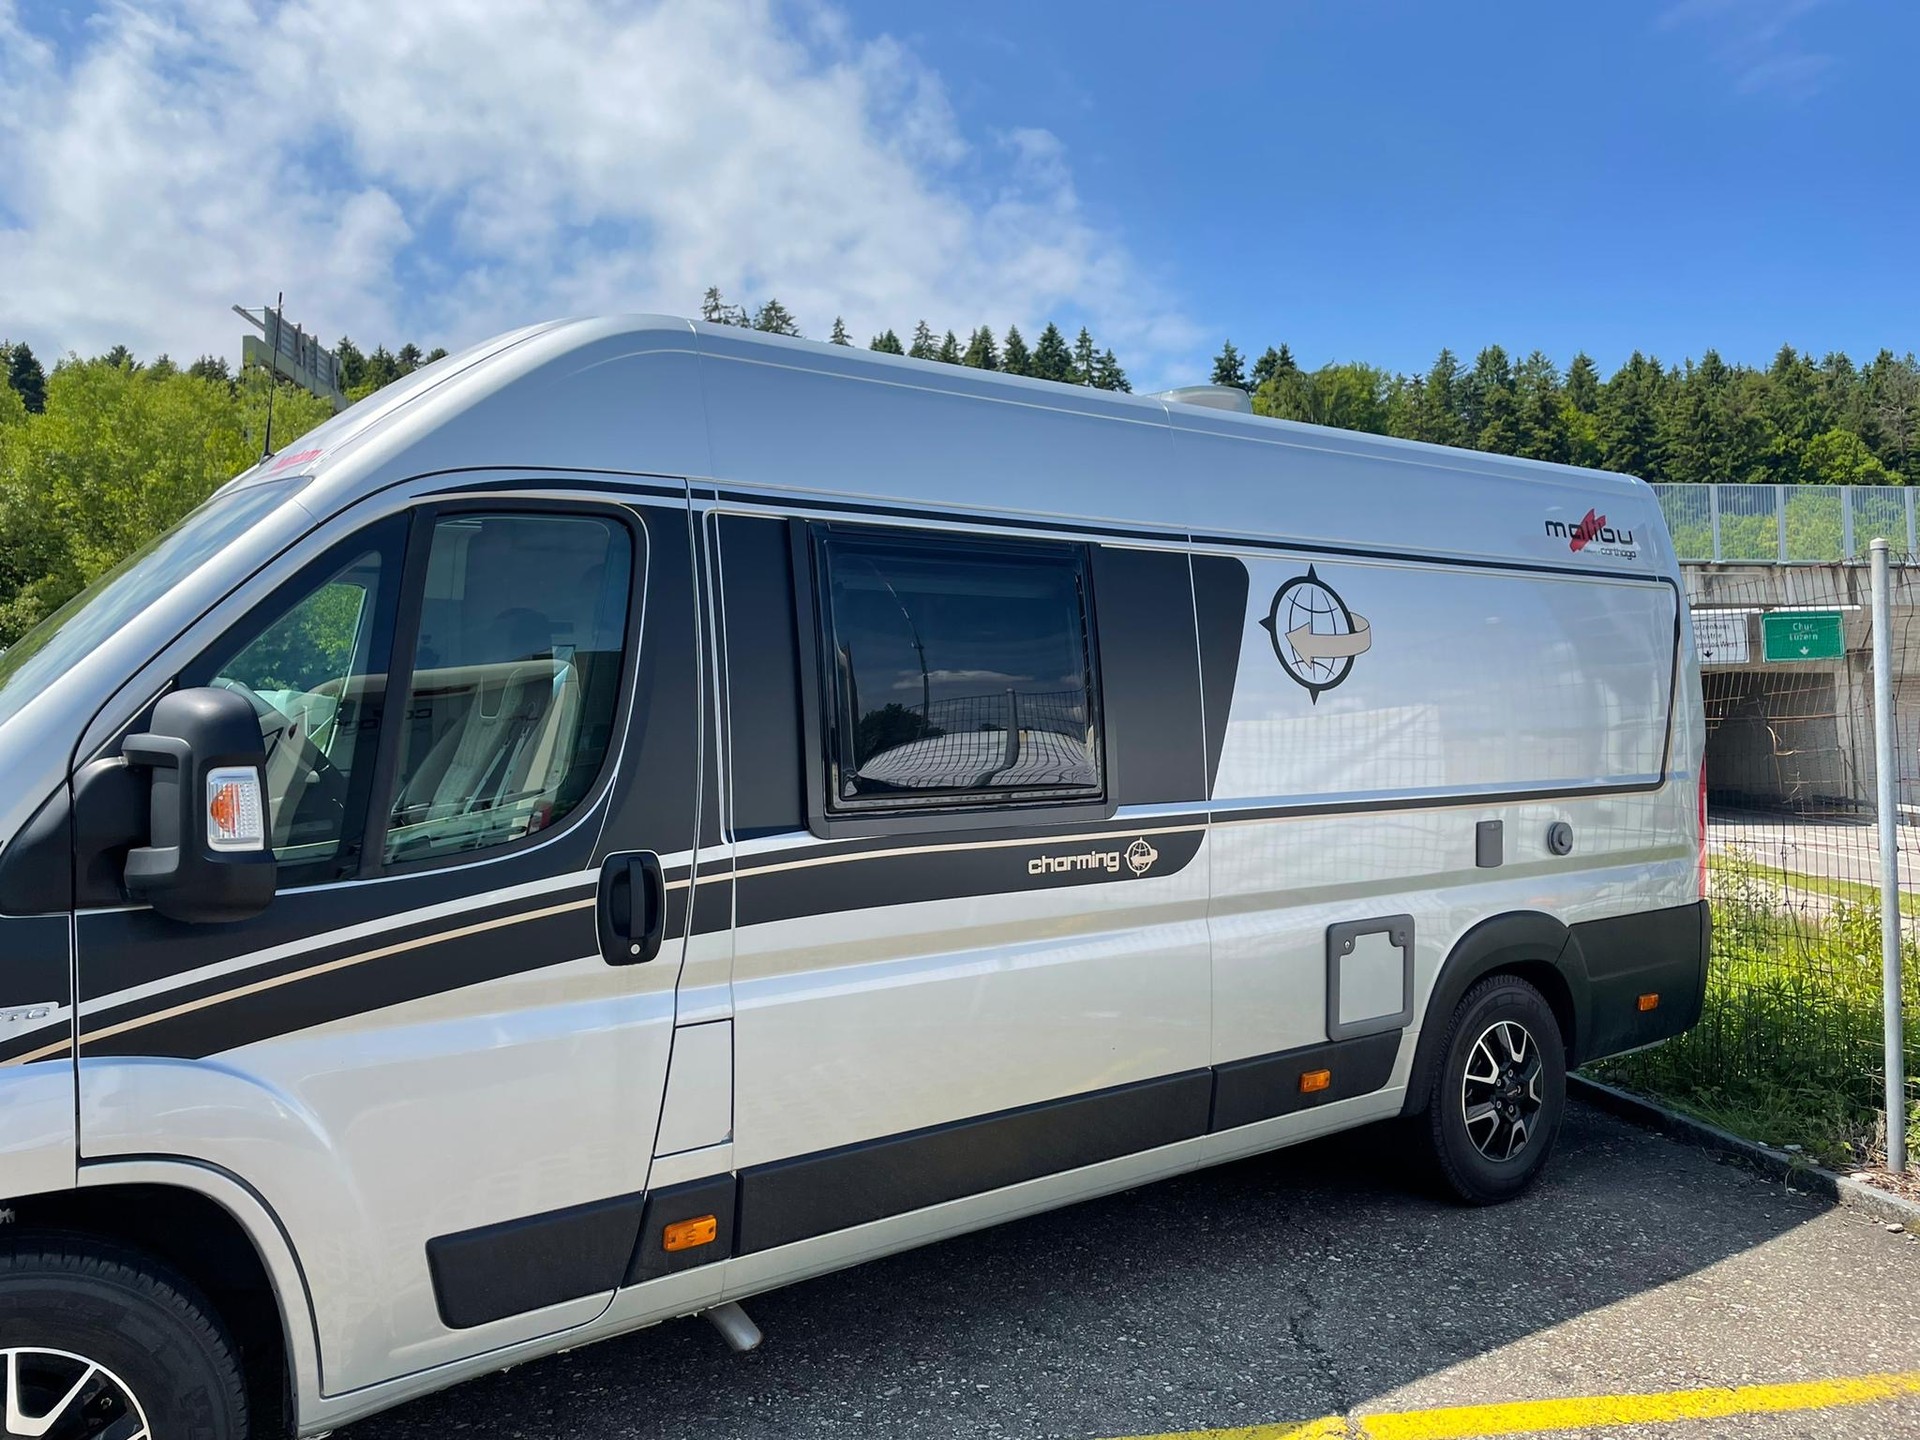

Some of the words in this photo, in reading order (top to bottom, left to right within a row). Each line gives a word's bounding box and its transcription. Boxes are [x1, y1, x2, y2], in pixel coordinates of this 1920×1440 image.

[1544, 519, 1635, 546] malibu
[1600, 547, 1638, 561] carthago
[1792, 622, 1814, 631] Chur
[1789, 633, 1819, 641] Luzern
[1028, 851, 1120, 875] charming
